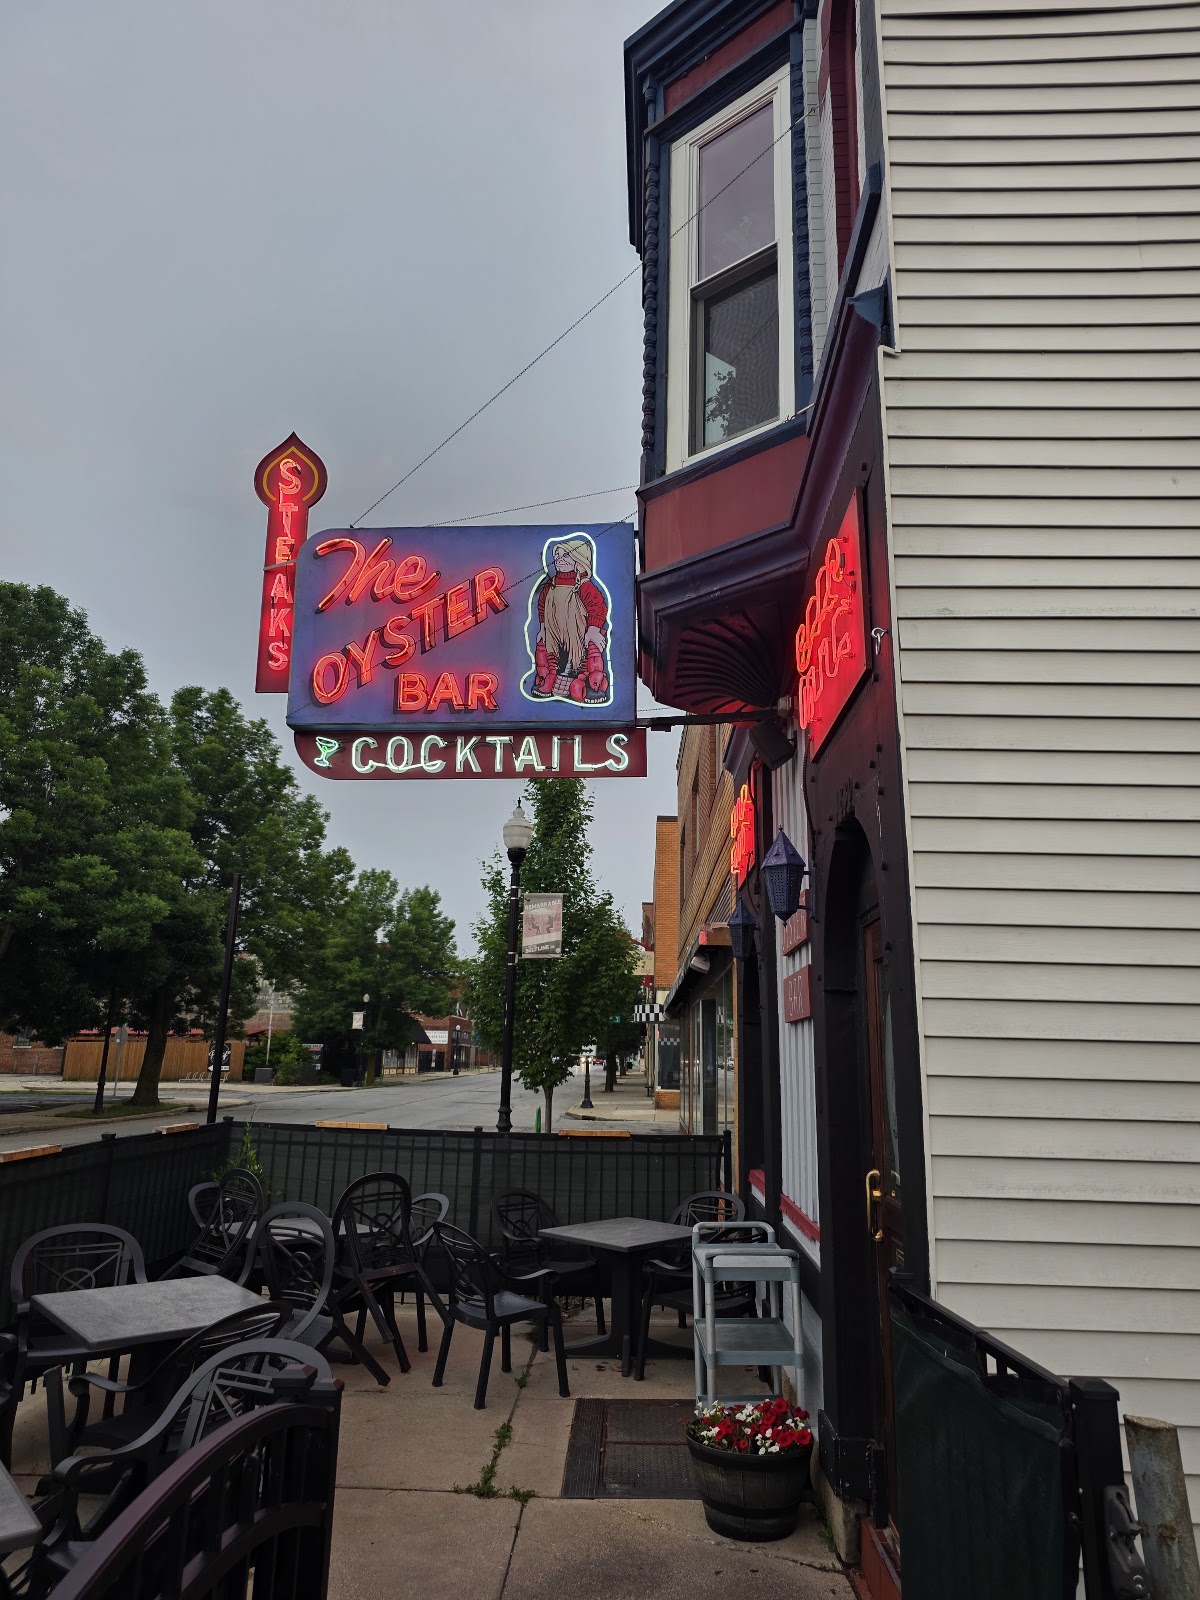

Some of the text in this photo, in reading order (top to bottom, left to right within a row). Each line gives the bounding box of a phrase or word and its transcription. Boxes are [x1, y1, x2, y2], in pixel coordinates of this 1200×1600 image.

[268, 458, 302, 670] STEAKS
[315, 536, 441, 613] The
[310, 566, 510, 705] OYSTER
[395, 672, 500, 712] BAR
[351, 733, 629, 774] COCKTAILS
[525, 899, 561, 910] REMARKABLE
